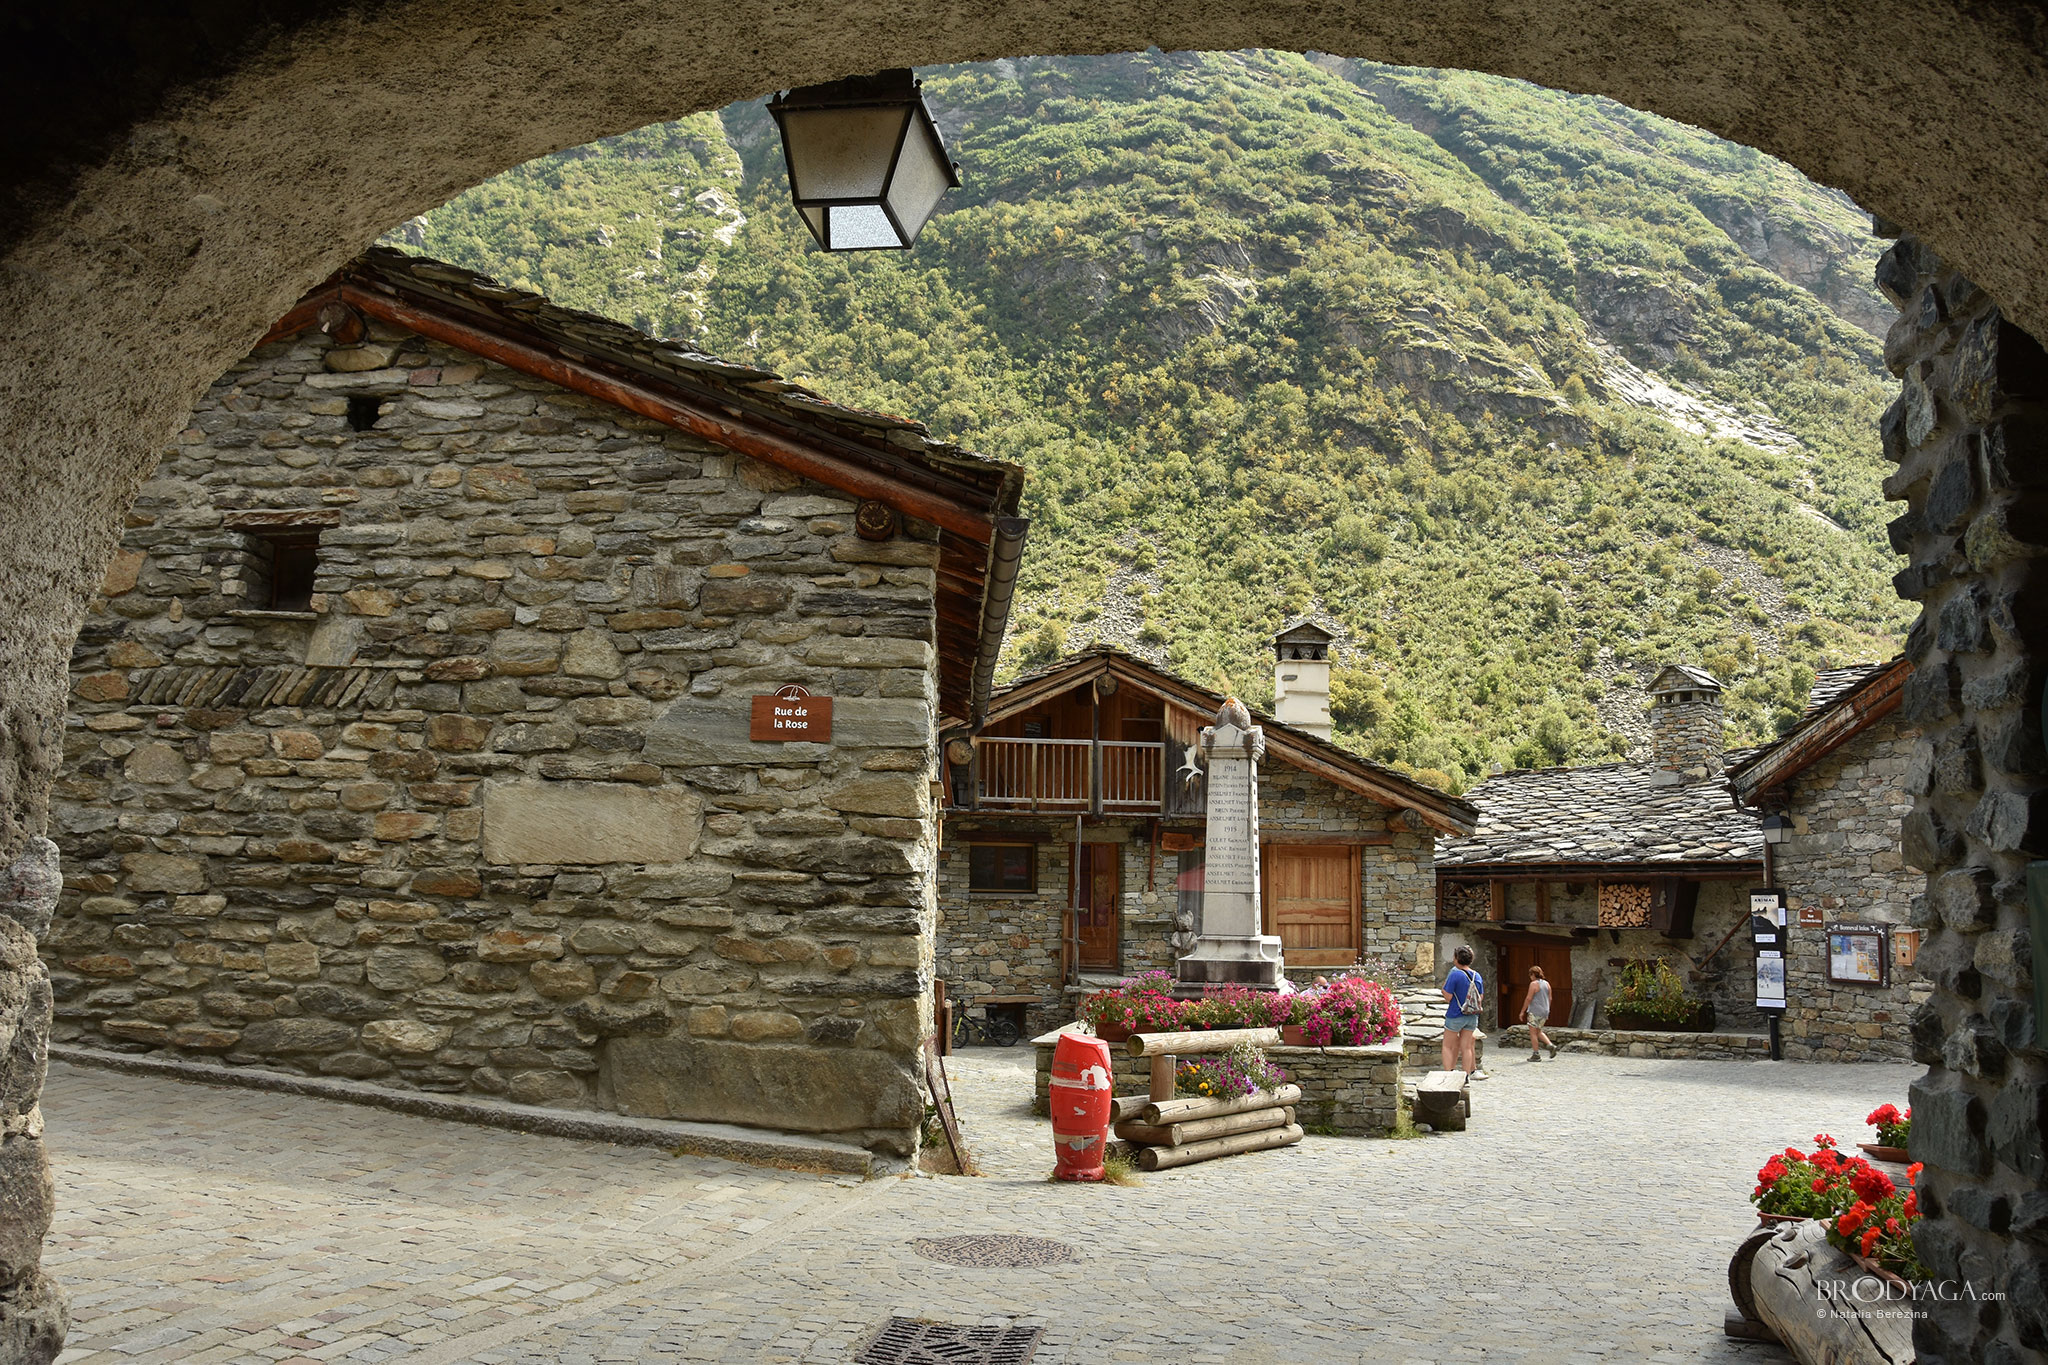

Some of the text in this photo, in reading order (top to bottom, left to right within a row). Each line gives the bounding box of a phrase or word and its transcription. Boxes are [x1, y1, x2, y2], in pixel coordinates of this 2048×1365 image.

[775, 705, 808, 716] Rue de
[774, 718, 808, 729] la Rose
